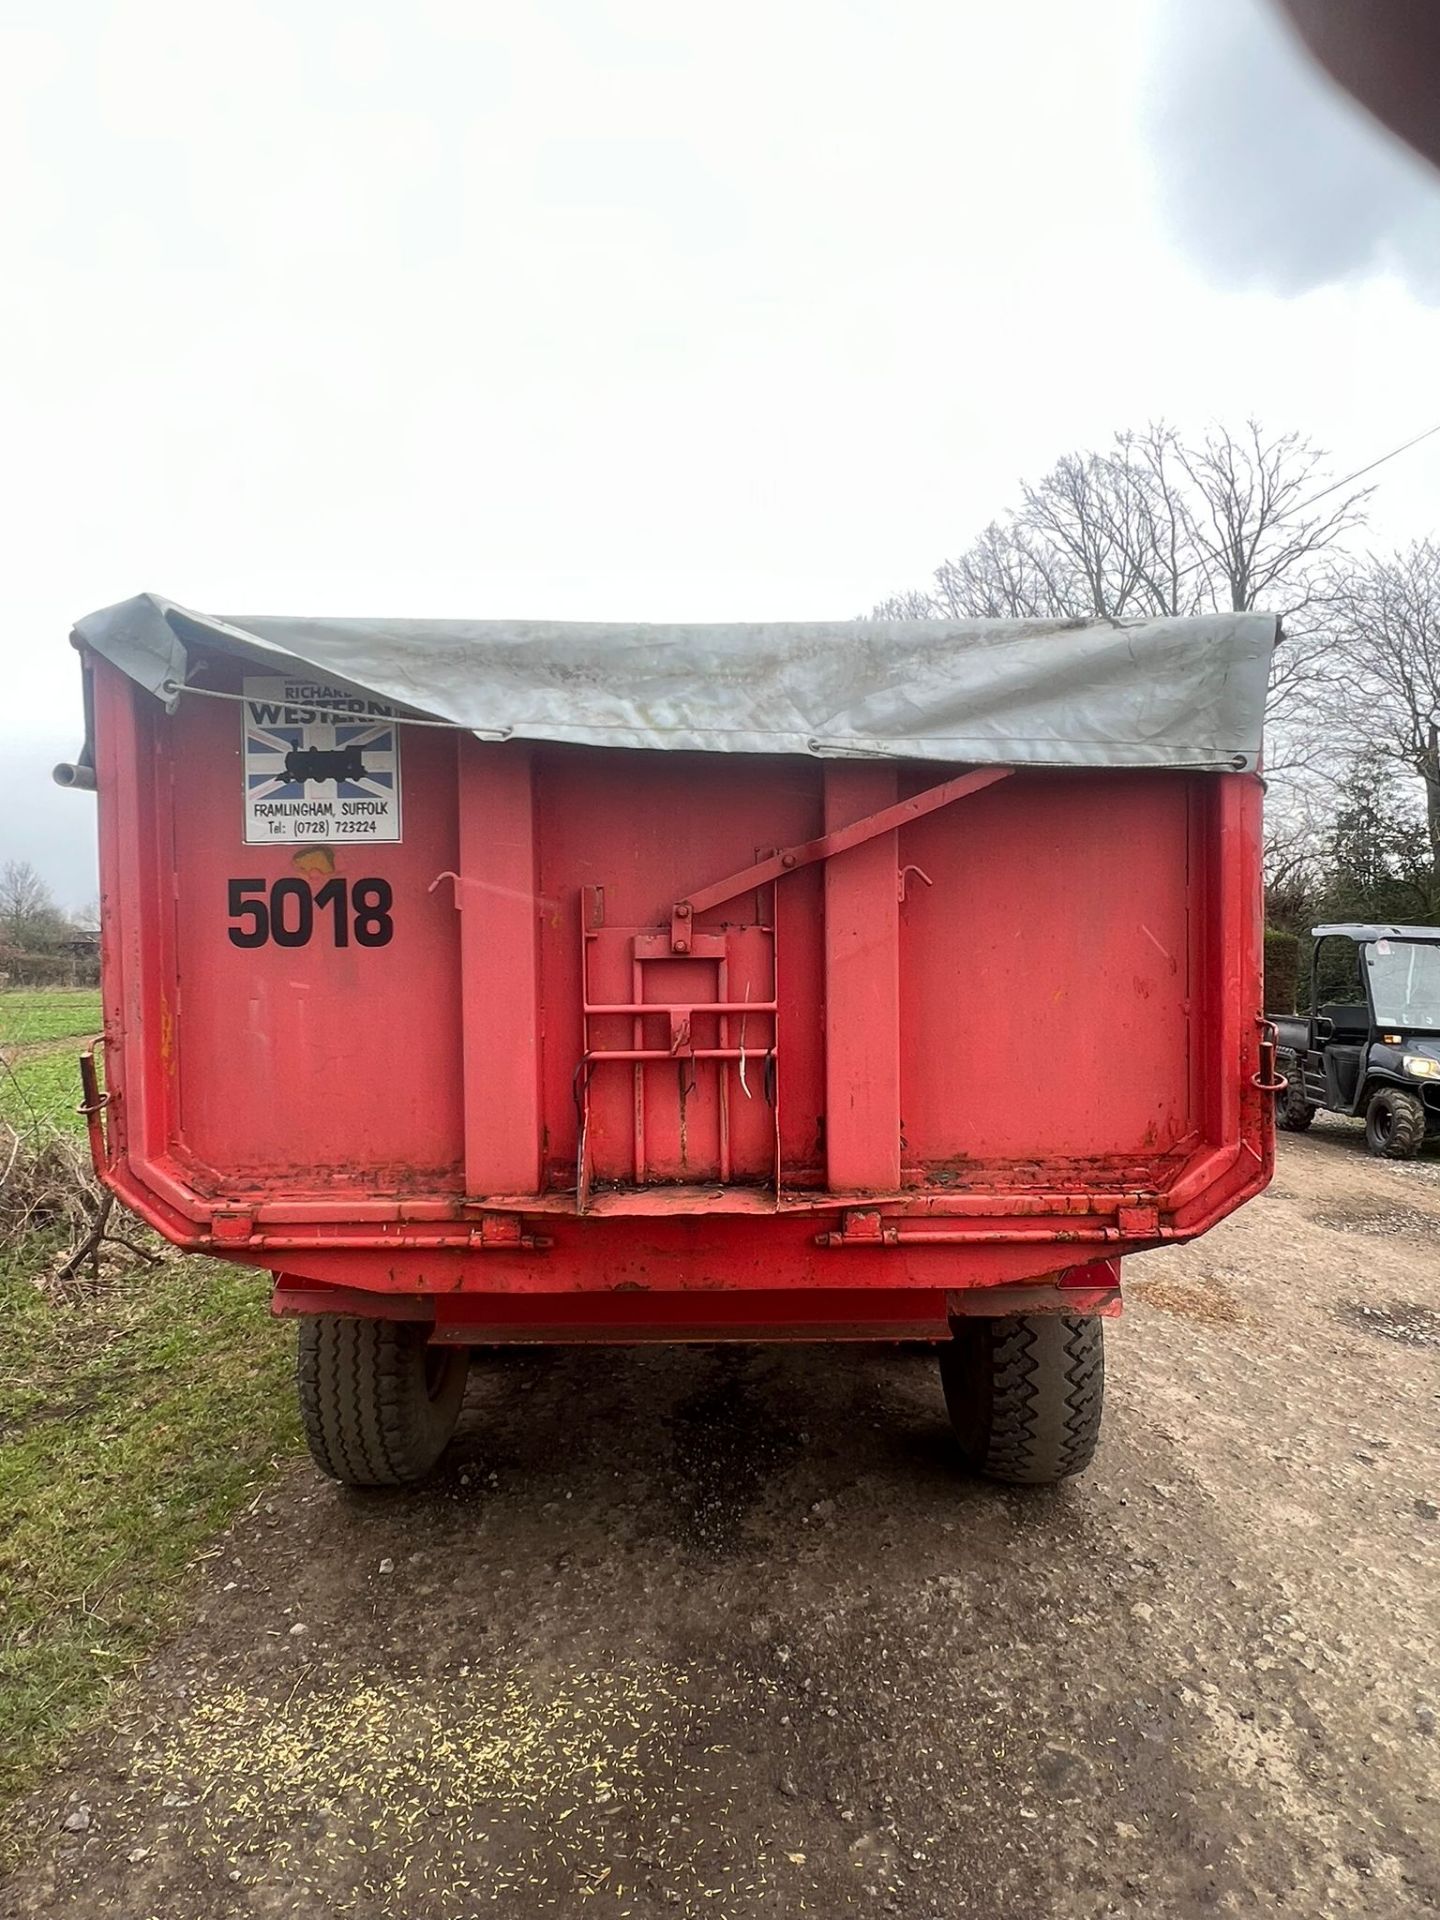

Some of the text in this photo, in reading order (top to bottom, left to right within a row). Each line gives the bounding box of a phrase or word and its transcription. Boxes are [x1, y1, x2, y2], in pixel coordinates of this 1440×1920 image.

[254, 801, 388, 818] FRAMLINGHAM, SUFFOLK
[268, 820, 377, 837] Tel: (0728) 723224
[228, 877, 394, 949] 5018
